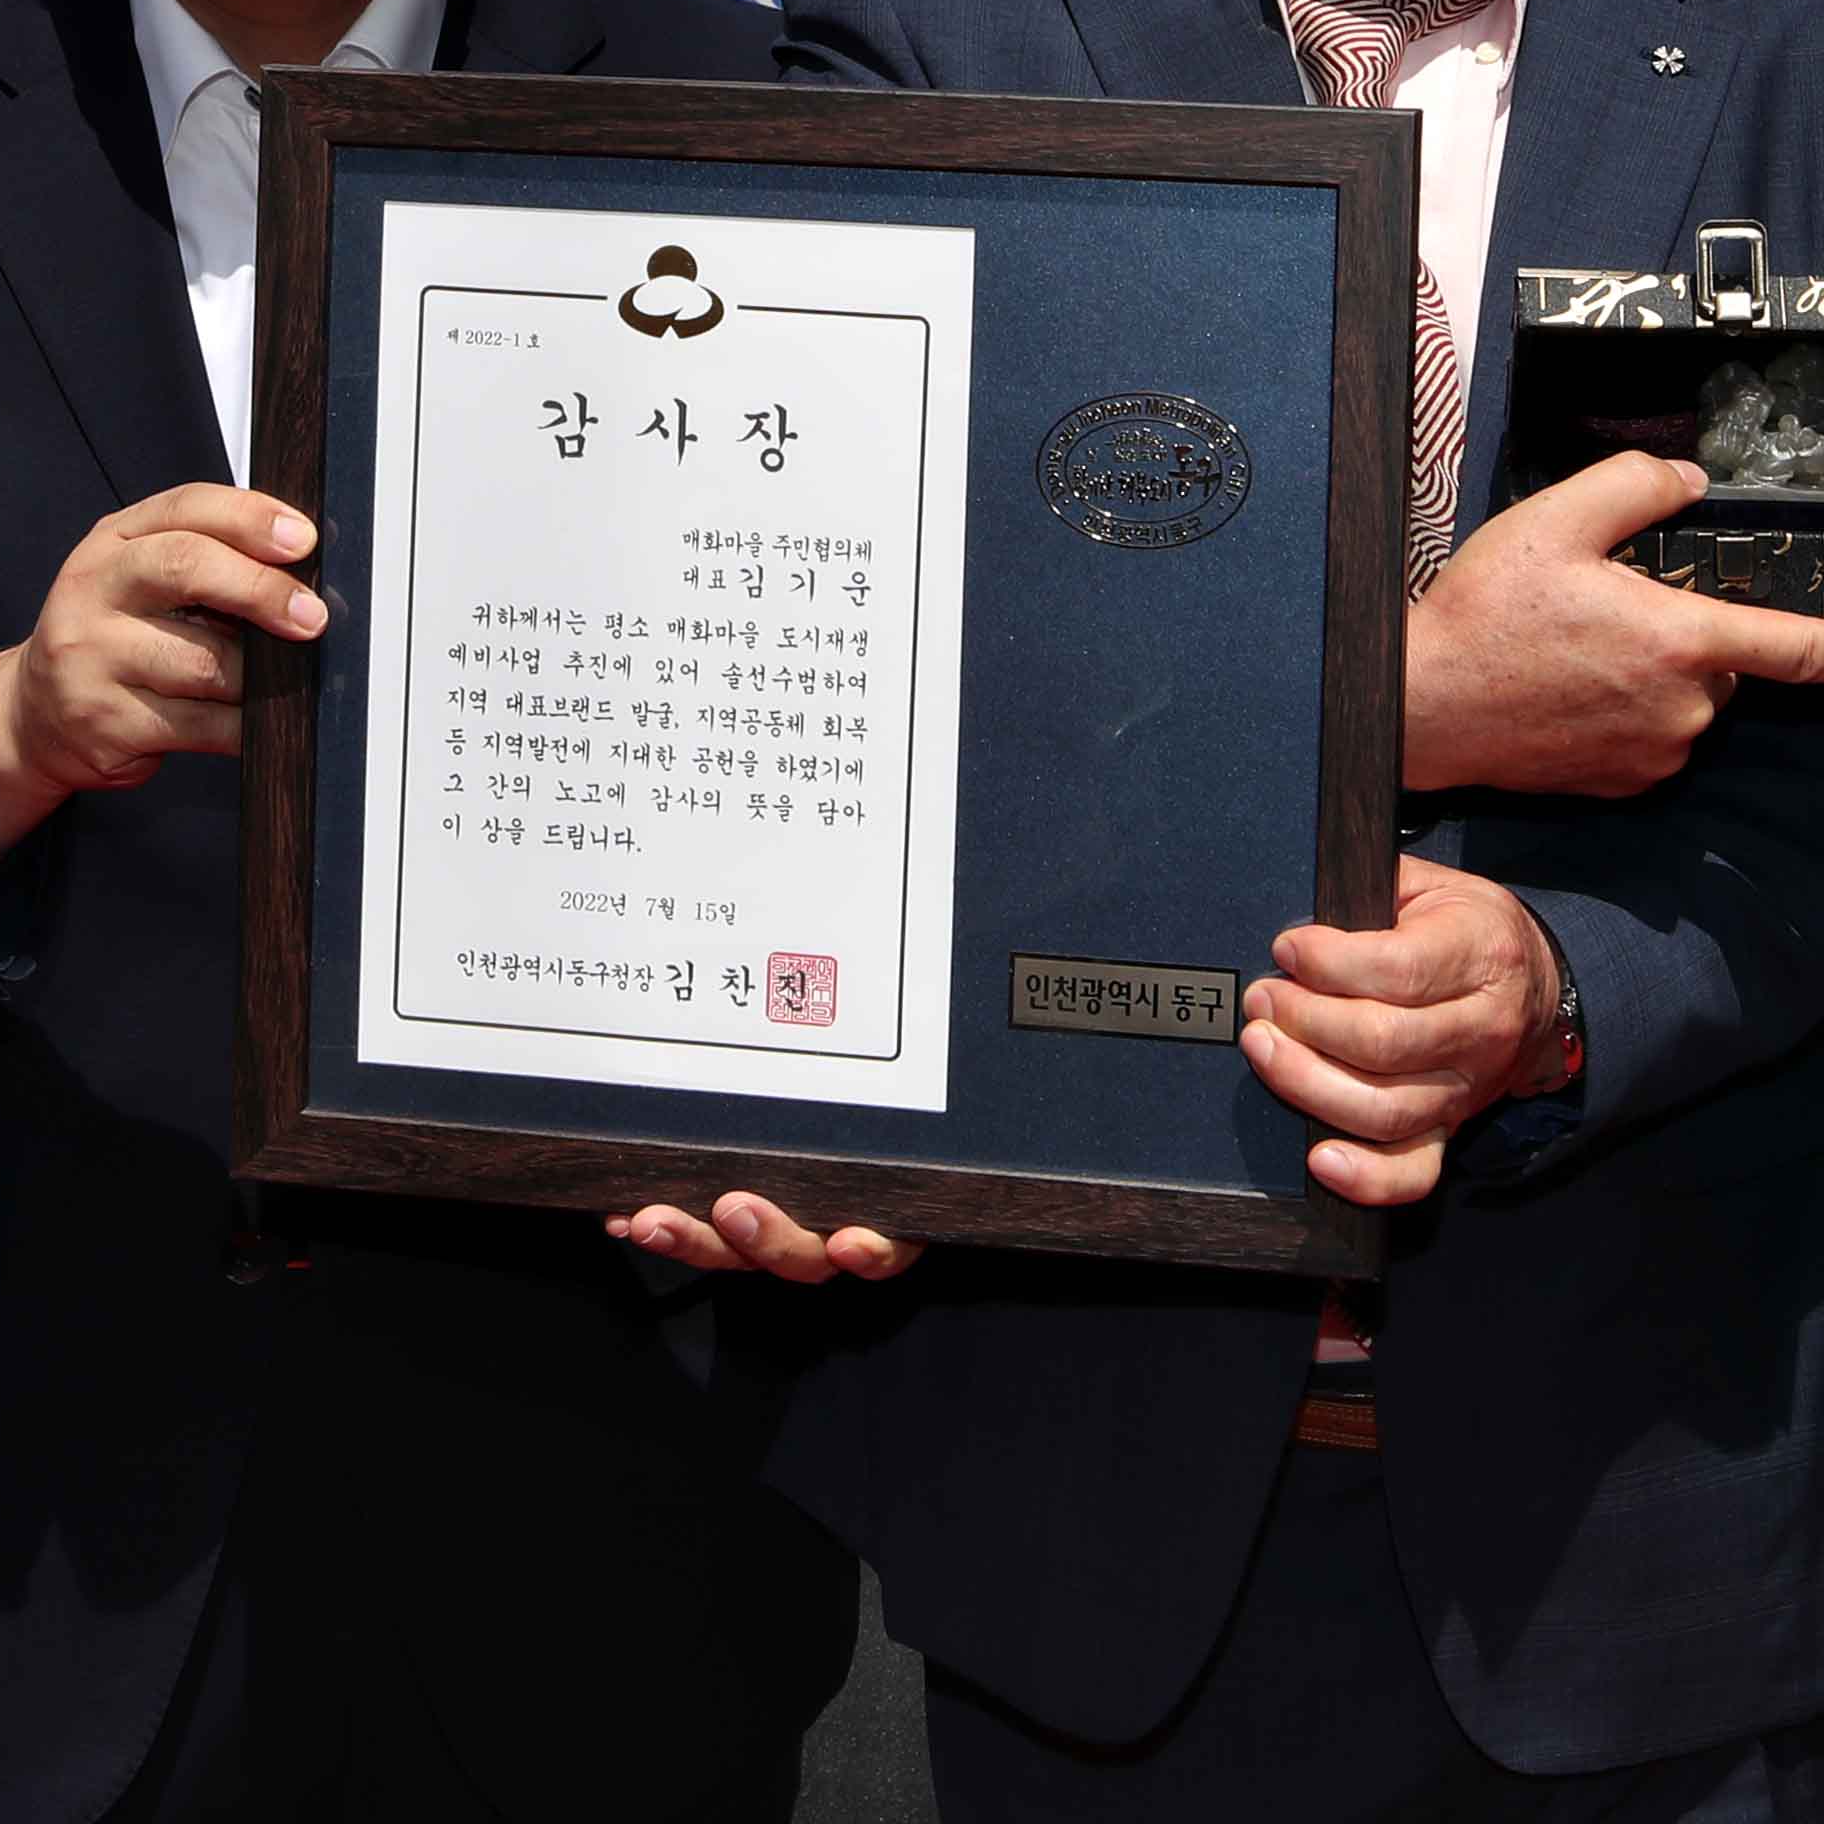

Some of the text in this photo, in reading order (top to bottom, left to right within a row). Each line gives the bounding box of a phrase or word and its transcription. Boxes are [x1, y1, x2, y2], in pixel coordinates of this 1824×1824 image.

[464, 328, 520, 348] 2022-1
[682, 529, 872, 563] 매화마을 주민협의체
[471, 602, 868, 657] 귀하께서는 평소 매화마을 도시재생
[448, 642, 867, 697] 예비사업 추진에 있어 솔선수범하여
[448, 686, 487, 715] 지역
[505, 691, 615, 723] 대표브랜드
[697, 705, 805, 738] 지역공동체
[823, 714, 868, 742] 회복
[445, 728, 863, 784] 등 지역발전에 지대한 공헌을 하였기에
[555, 780, 625, 807] 노고에
[652, 785, 721, 814] 감사의
[747, 793, 794, 823] 뜻을
[817, 798, 865, 826] 담아
[442, 813, 461, 838] 이
[481, 816, 526, 846] 상을
[560, 890, 736, 926] 2022년 7월 15일
[1026, 974, 1224, 1023] 인천광역시 동구
